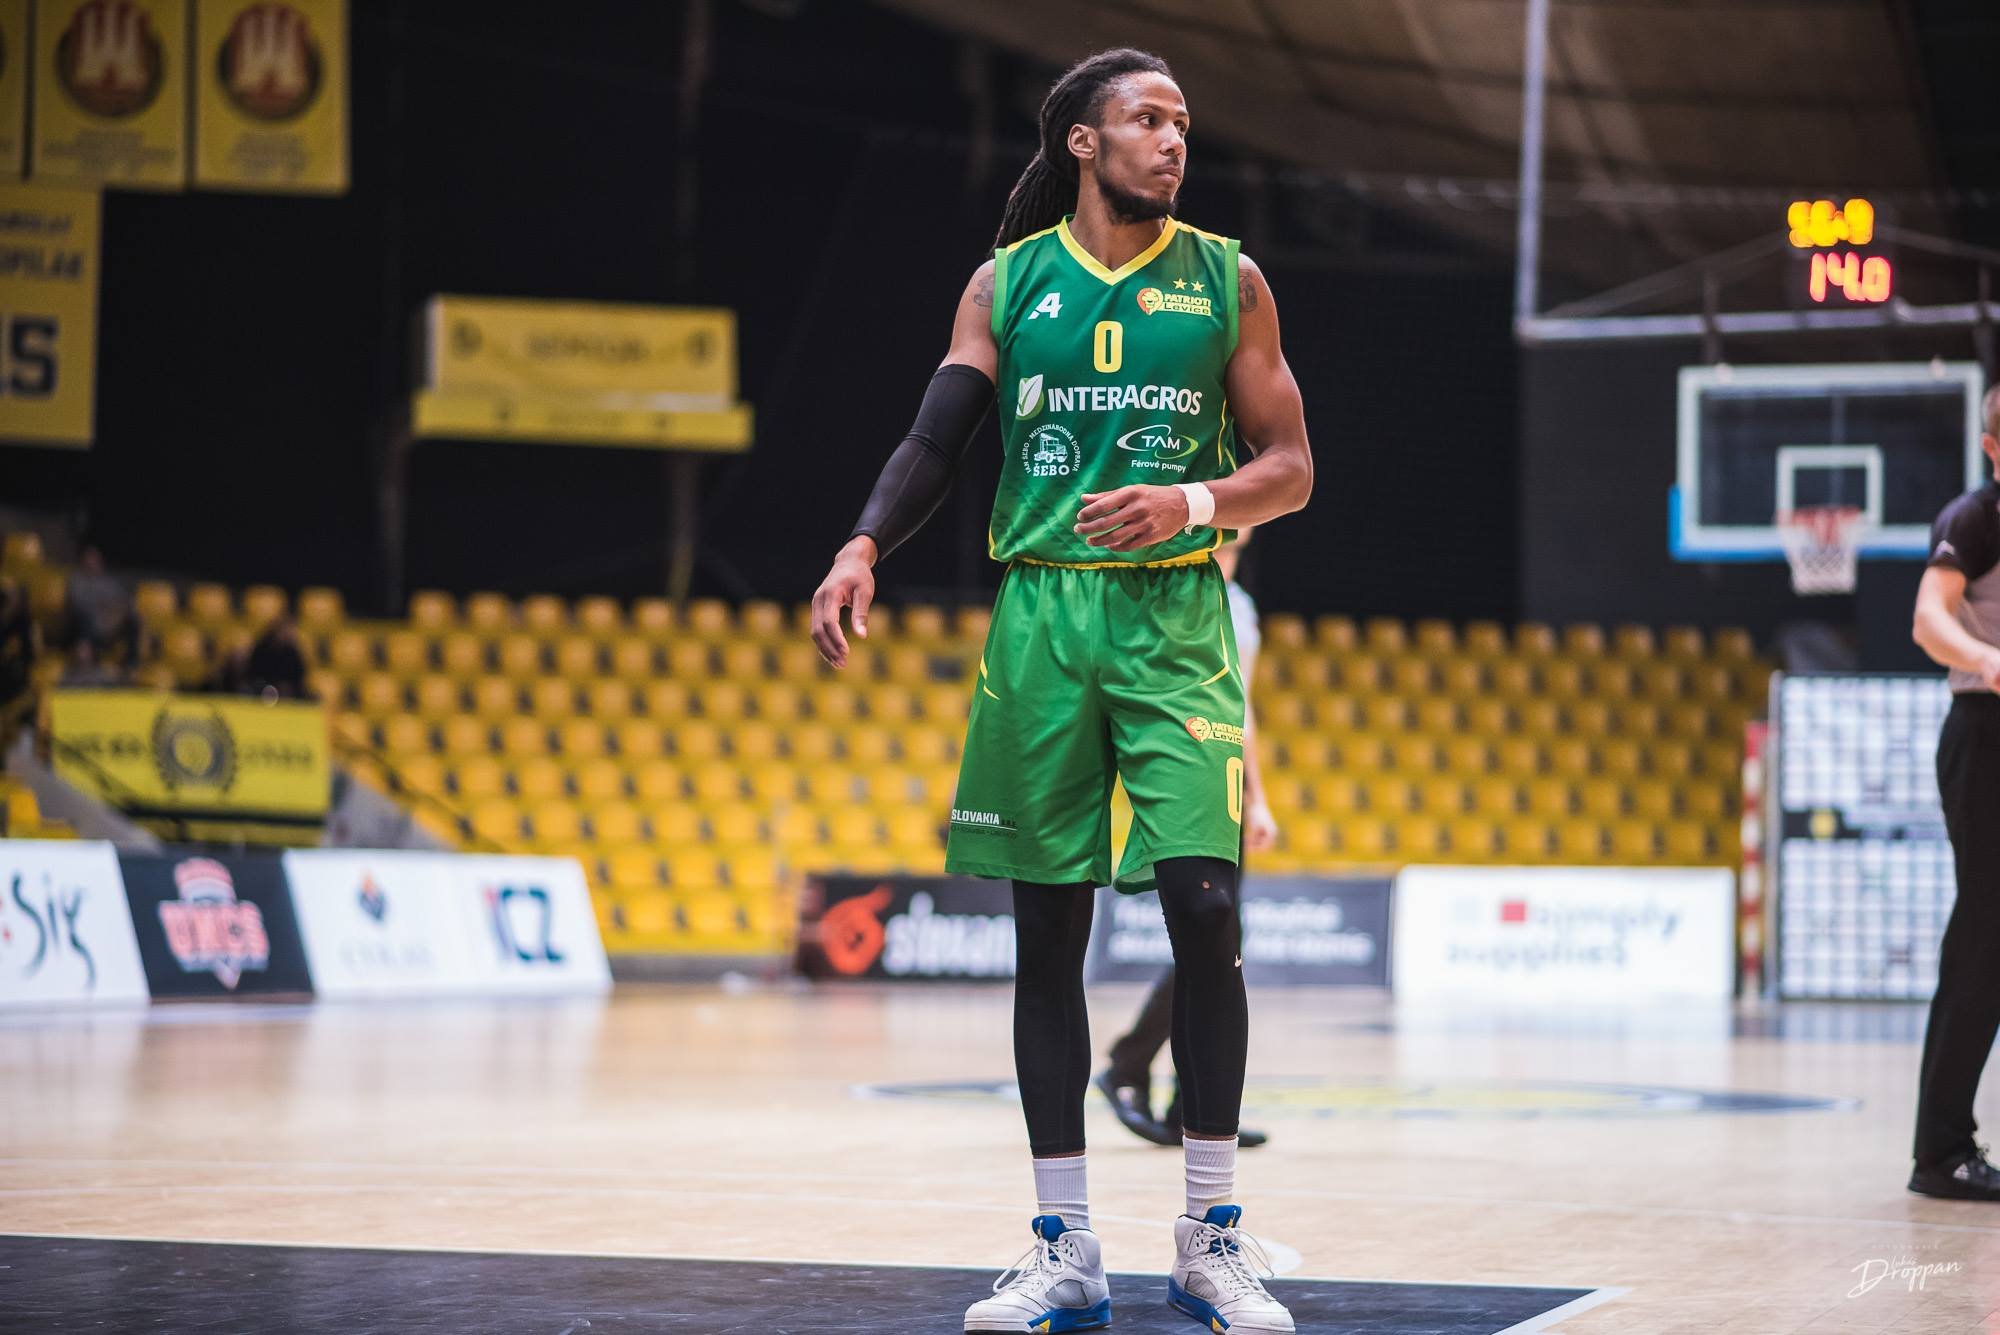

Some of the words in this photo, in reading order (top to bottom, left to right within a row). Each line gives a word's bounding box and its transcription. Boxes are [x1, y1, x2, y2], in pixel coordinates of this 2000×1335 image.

[1164, 294, 1212, 307] PATRIOTI
[1164, 303, 1210, 314] Levice
[1093, 320, 1123, 374] 0
[1047, 384, 1203, 416] INTERAGROS
[1141, 435, 1181, 451] TAM
[1032, 463, 1070, 477] ŠEBO
[1162, 462, 1187, 474] pumpy
[1212, 722, 1244, 736] PATRIO
[951, 808, 1000, 825] SLOVAKIA
